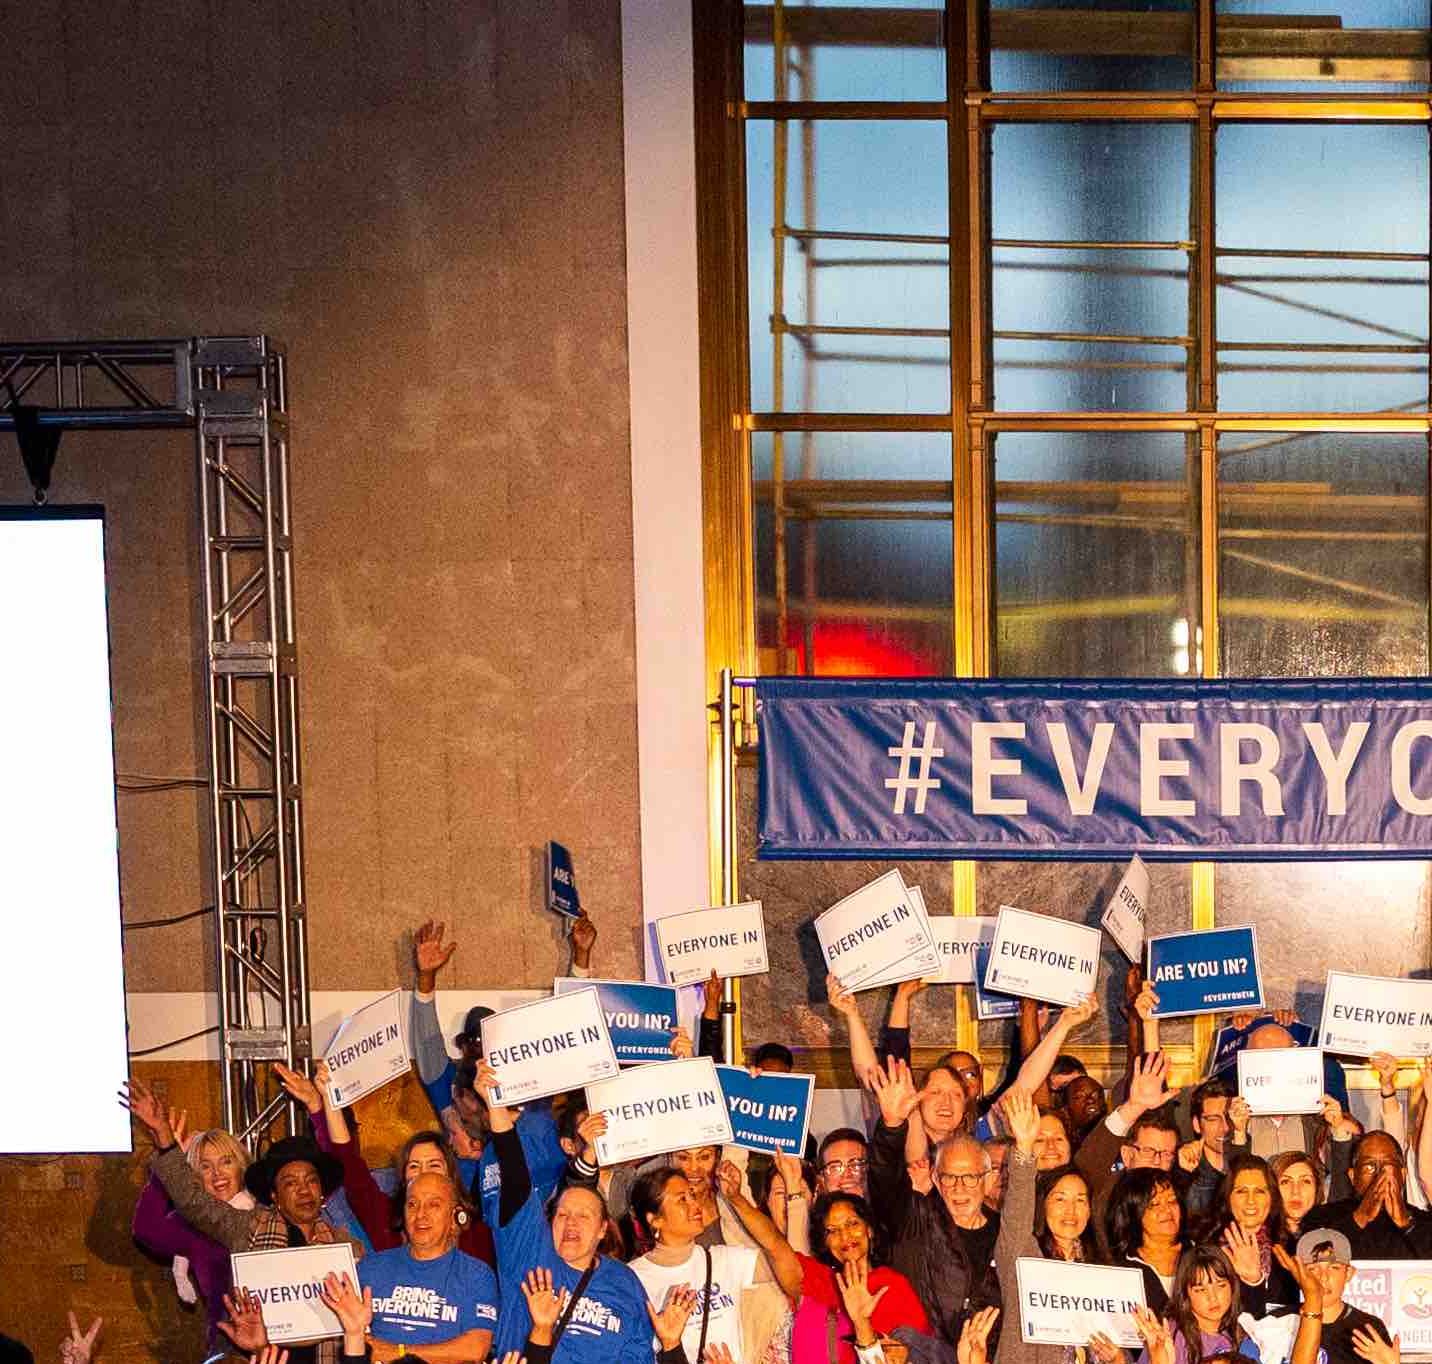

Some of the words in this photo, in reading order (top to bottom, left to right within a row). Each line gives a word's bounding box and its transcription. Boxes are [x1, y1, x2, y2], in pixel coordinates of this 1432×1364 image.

[827, 911, 894, 960] EVERYONE
[893, 902, 910, 925] IN
[667, 932, 738, 958] EVERYONE
[743, 930, 758, 944] IN
[1002, 941, 1075, 971] EVERYONE
[1080, 959, 1093, 975] IN
[1155, 965, 1184, 982] ARE
[1187, 961, 1219, 979] YOU
[1223, 957, 1248, 975] IN?
[1203, 991, 1255, 1003] #EVERYONEIN
[606, 1013, 639, 1030] YOU
[644, 1013, 671, 1030] IN?
[1333, 1004, 1418, 1026] EVERYONE
[328, 1031, 384, 1073] EVERYONE
[386, 1023, 399, 1041] IN
[489, 1032, 577, 1068] EVERYONE
[581, 1025, 601, 1044] IN
[698, 1090, 716, 1107] IN
[729, 1096, 763, 1117] YOU
[768, 1104, 798, 1122] IN?
[737, 1131, 796, 1148] #EVERYONEIN
[392, 1286, 438, 1302] BRING
[1029, 1291, 1116, 1313] EVERYONE
[1121, 1300, 1138, 1315] IN
[372, 1298, 439, 1320] EVERYONE
[441, 1305, 458, 1322] IN
